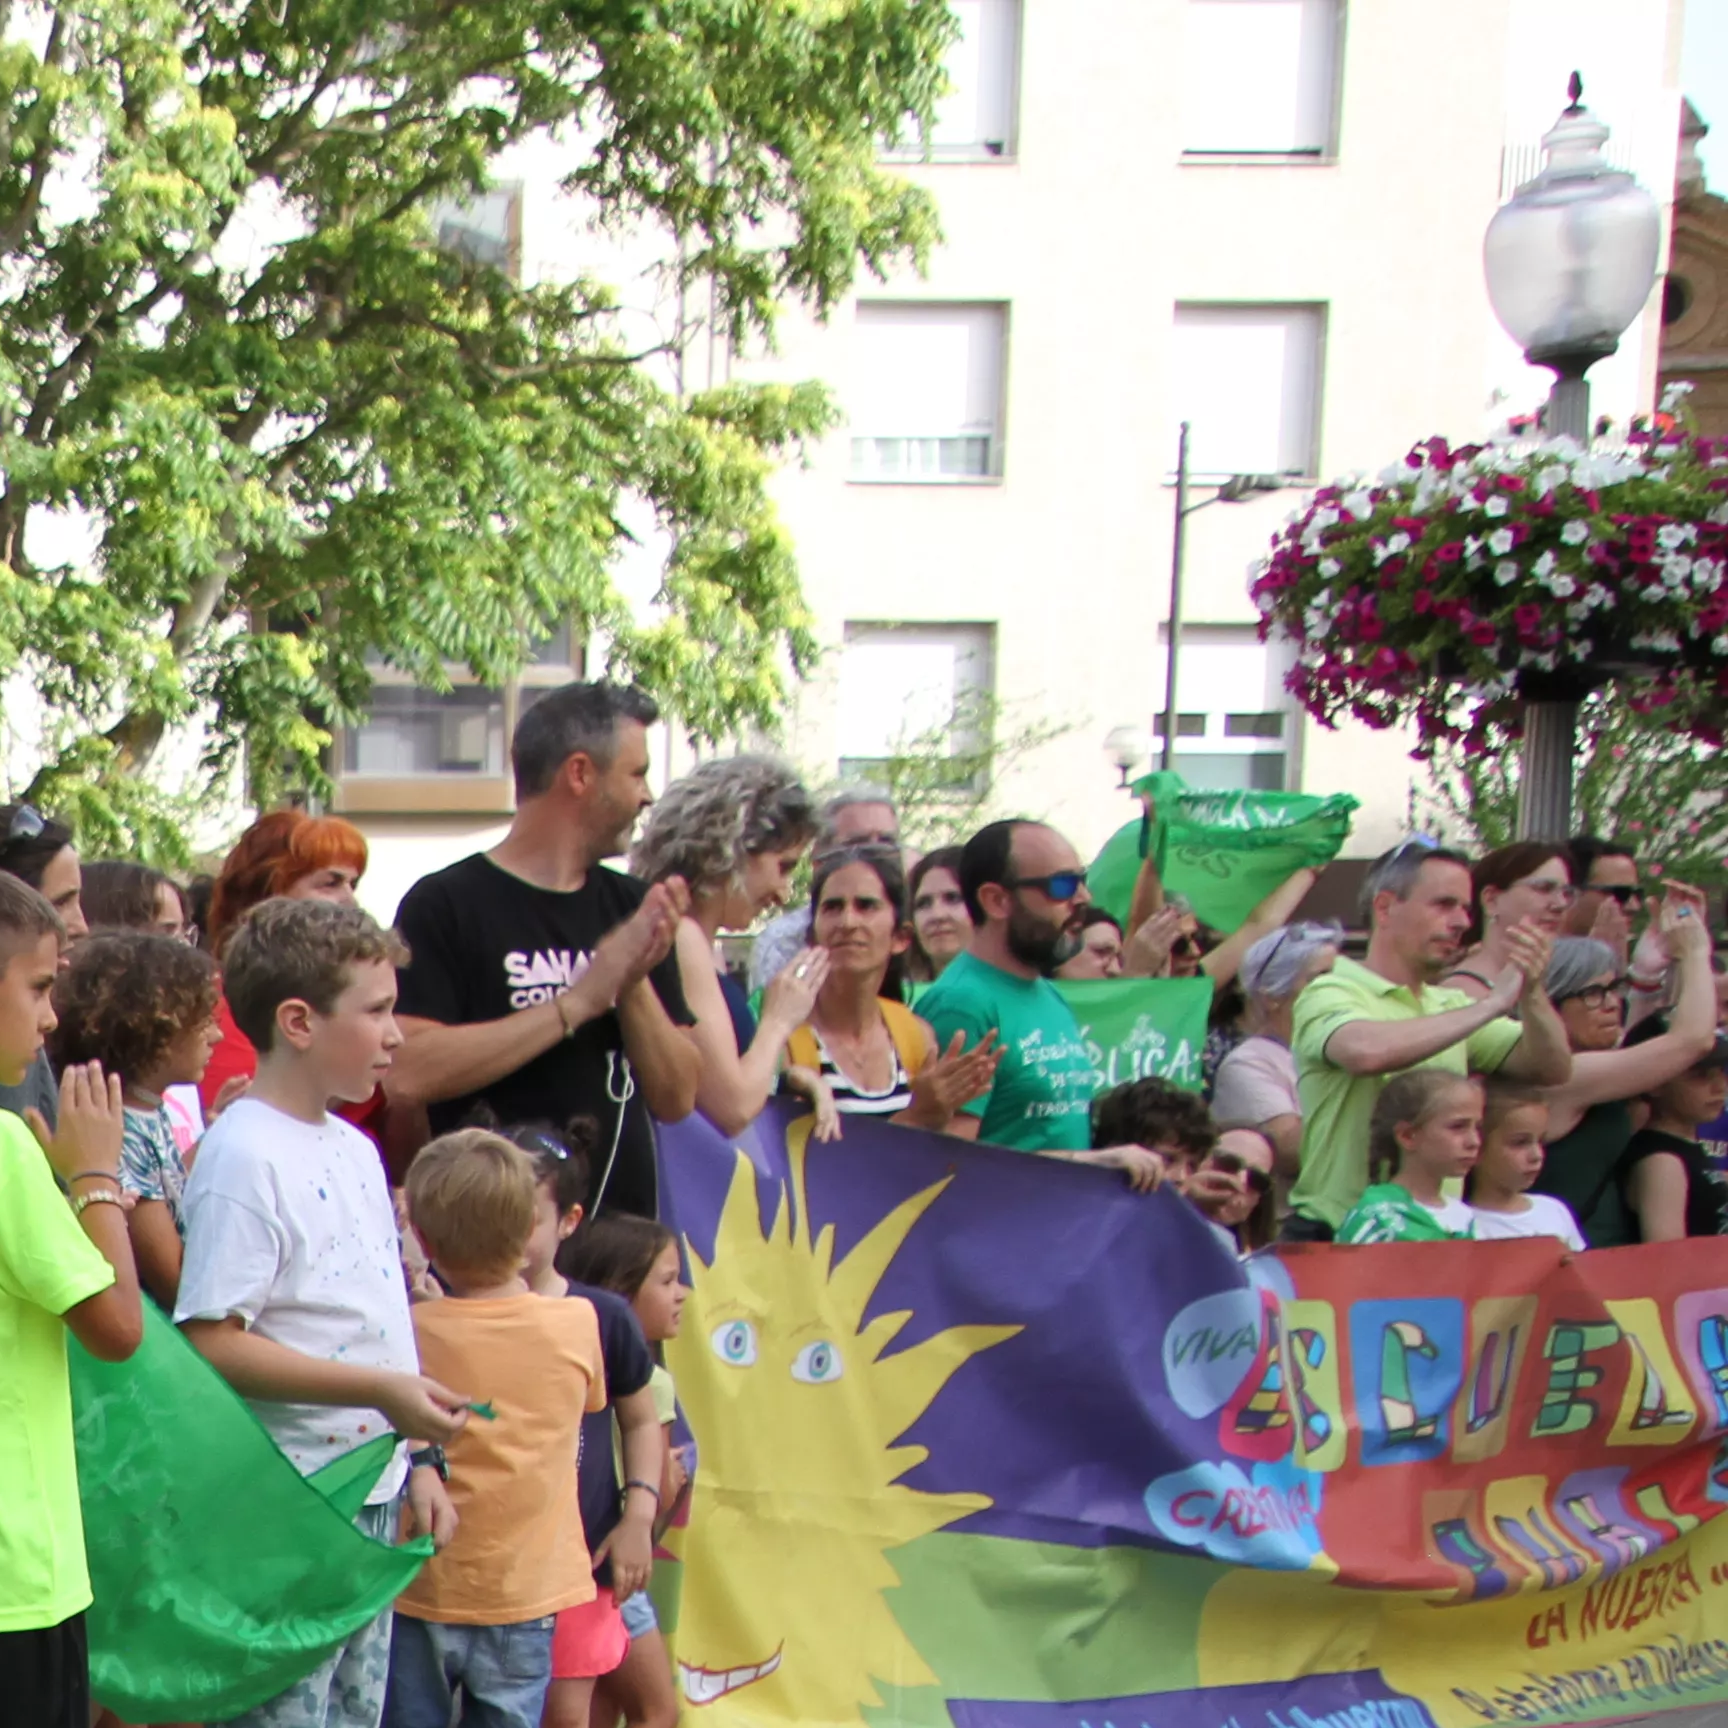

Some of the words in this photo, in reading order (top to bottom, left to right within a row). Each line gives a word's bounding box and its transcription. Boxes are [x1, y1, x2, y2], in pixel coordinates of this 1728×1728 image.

[503, 947, 597, 988] SAHA
[1171, 1321, 1258, 1369] VIVA
[1526, 1602, 1568, 1649] LA
